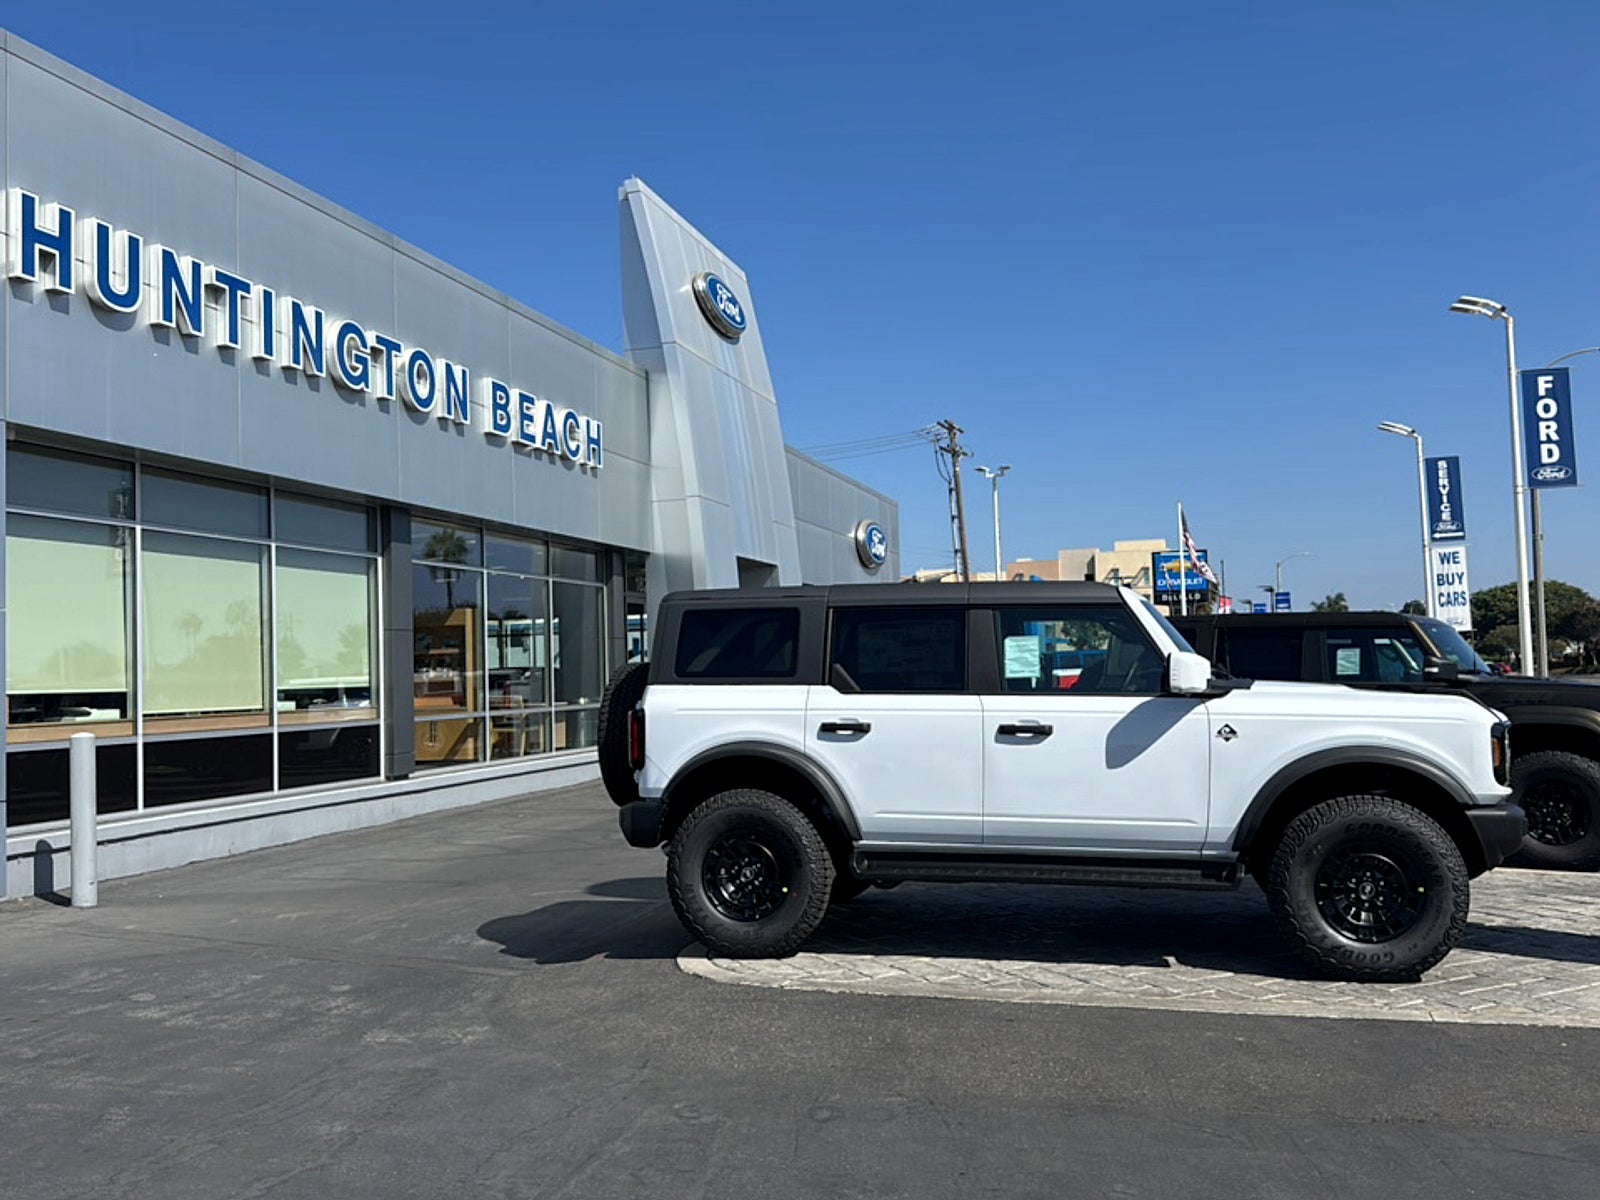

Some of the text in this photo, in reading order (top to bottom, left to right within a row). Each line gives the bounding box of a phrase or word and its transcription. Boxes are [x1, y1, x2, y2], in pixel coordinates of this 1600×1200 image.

[716, 283, 741, 323] Ford
[9, 187, 603, 468] HUNTINGTON BEACH
[1536, 375, 1560, 464] FORD
[1537, 467, 1567, 480] Ford
[1439, 551, 1460, 564] WE
[1437, 572, 1464, 586] BUY
[1439, 591, 1467, 607] CARS
